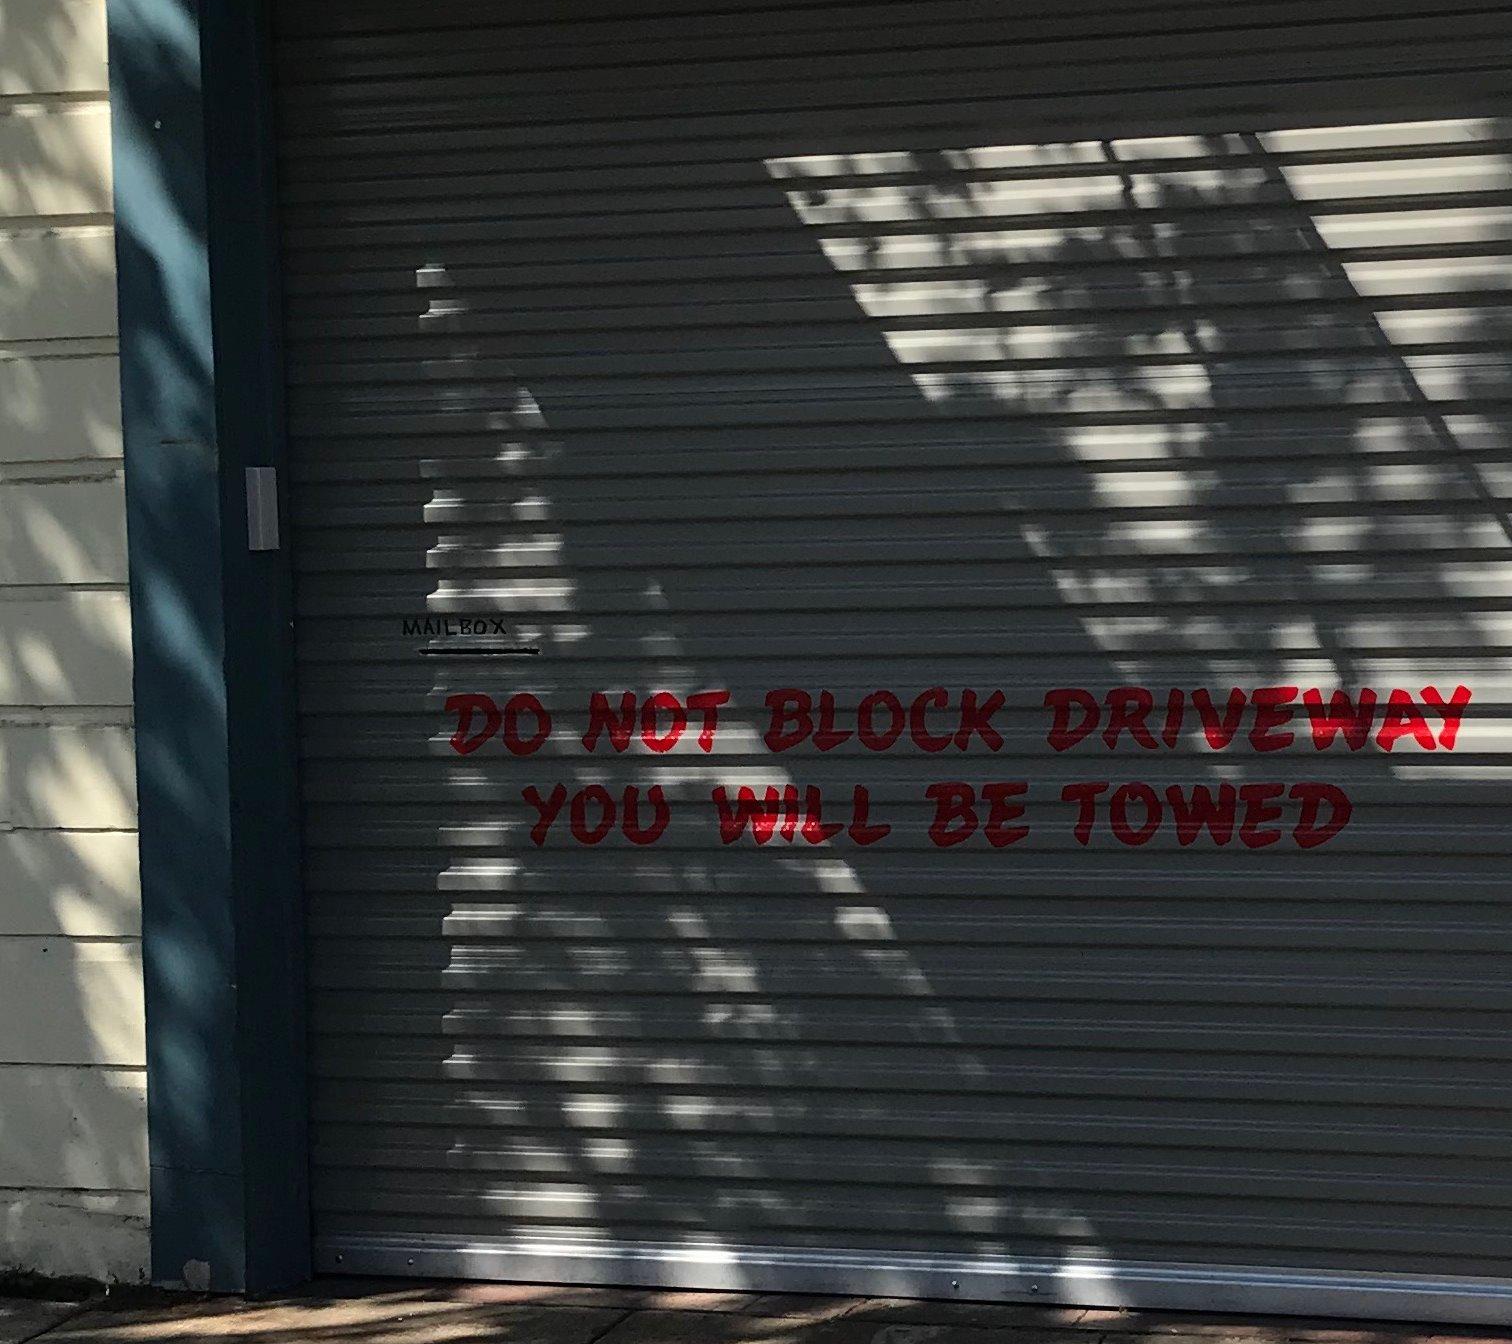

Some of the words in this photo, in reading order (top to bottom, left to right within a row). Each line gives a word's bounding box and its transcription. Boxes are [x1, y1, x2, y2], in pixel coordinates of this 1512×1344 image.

[403, 618, 507, 636] MAILBOX
[445, 692, 552, 755] DO
[582, 689, 730, 753] NOT
[764, 688, 1005, 753] BLOCK
[1044, 683, 1474, 753] DRIVEWAY
[521, 783, 670, 846] YOU
[712, 784, 891, 846] WILL
[925, 782, 1031, 848] BE
[1061, 780, 1353, 849] TOWED
